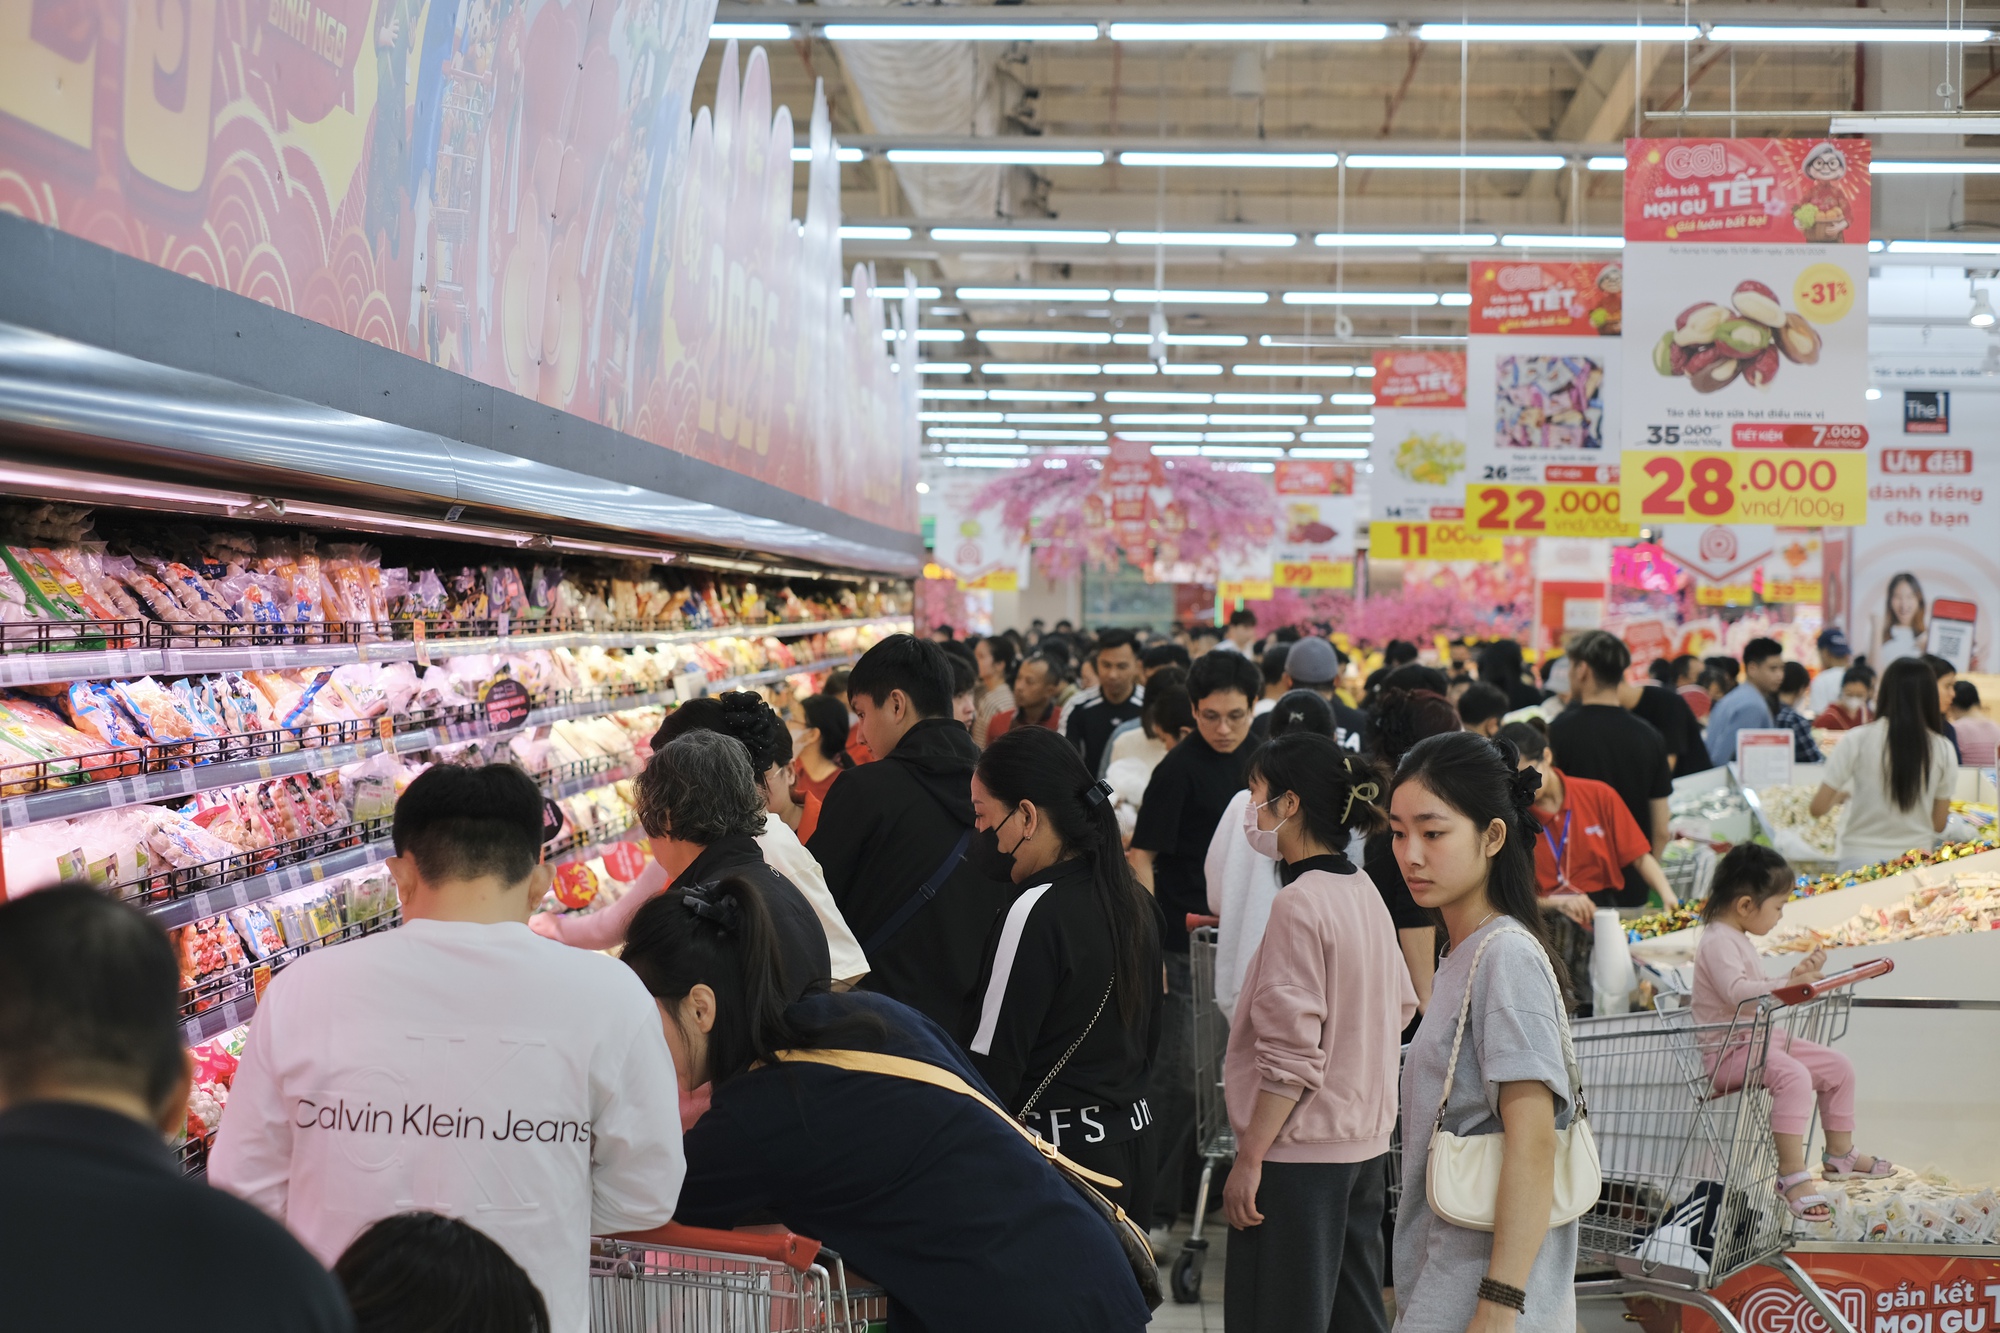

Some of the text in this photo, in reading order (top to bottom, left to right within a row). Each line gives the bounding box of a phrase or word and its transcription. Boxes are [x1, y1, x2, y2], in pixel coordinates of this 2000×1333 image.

[1708, 167, 1774, 208] TẾT
[1643, 198, 1708, 220] MỌI GU
[1527, 281, 1577, 312] TẾT
[1801, 280, 1848, 305] -31%
[697, 241, 781, 458] 2026
[1885, 450, 1966, 472] Ưu đãi
[1869, 482, 1983, 504] dành riêng
[1741, 496, 1845, 520] vnd/100g
[1884, 509, 1970, 528] cho bạn
[295, 1098, 590, 1143] Calvin Klein Jeans
[1876, 1281, 1926, 1312] gắn
[1933, 1278, 1976, 1305] kết
[1939, 1307, 1986, 1333] GU
